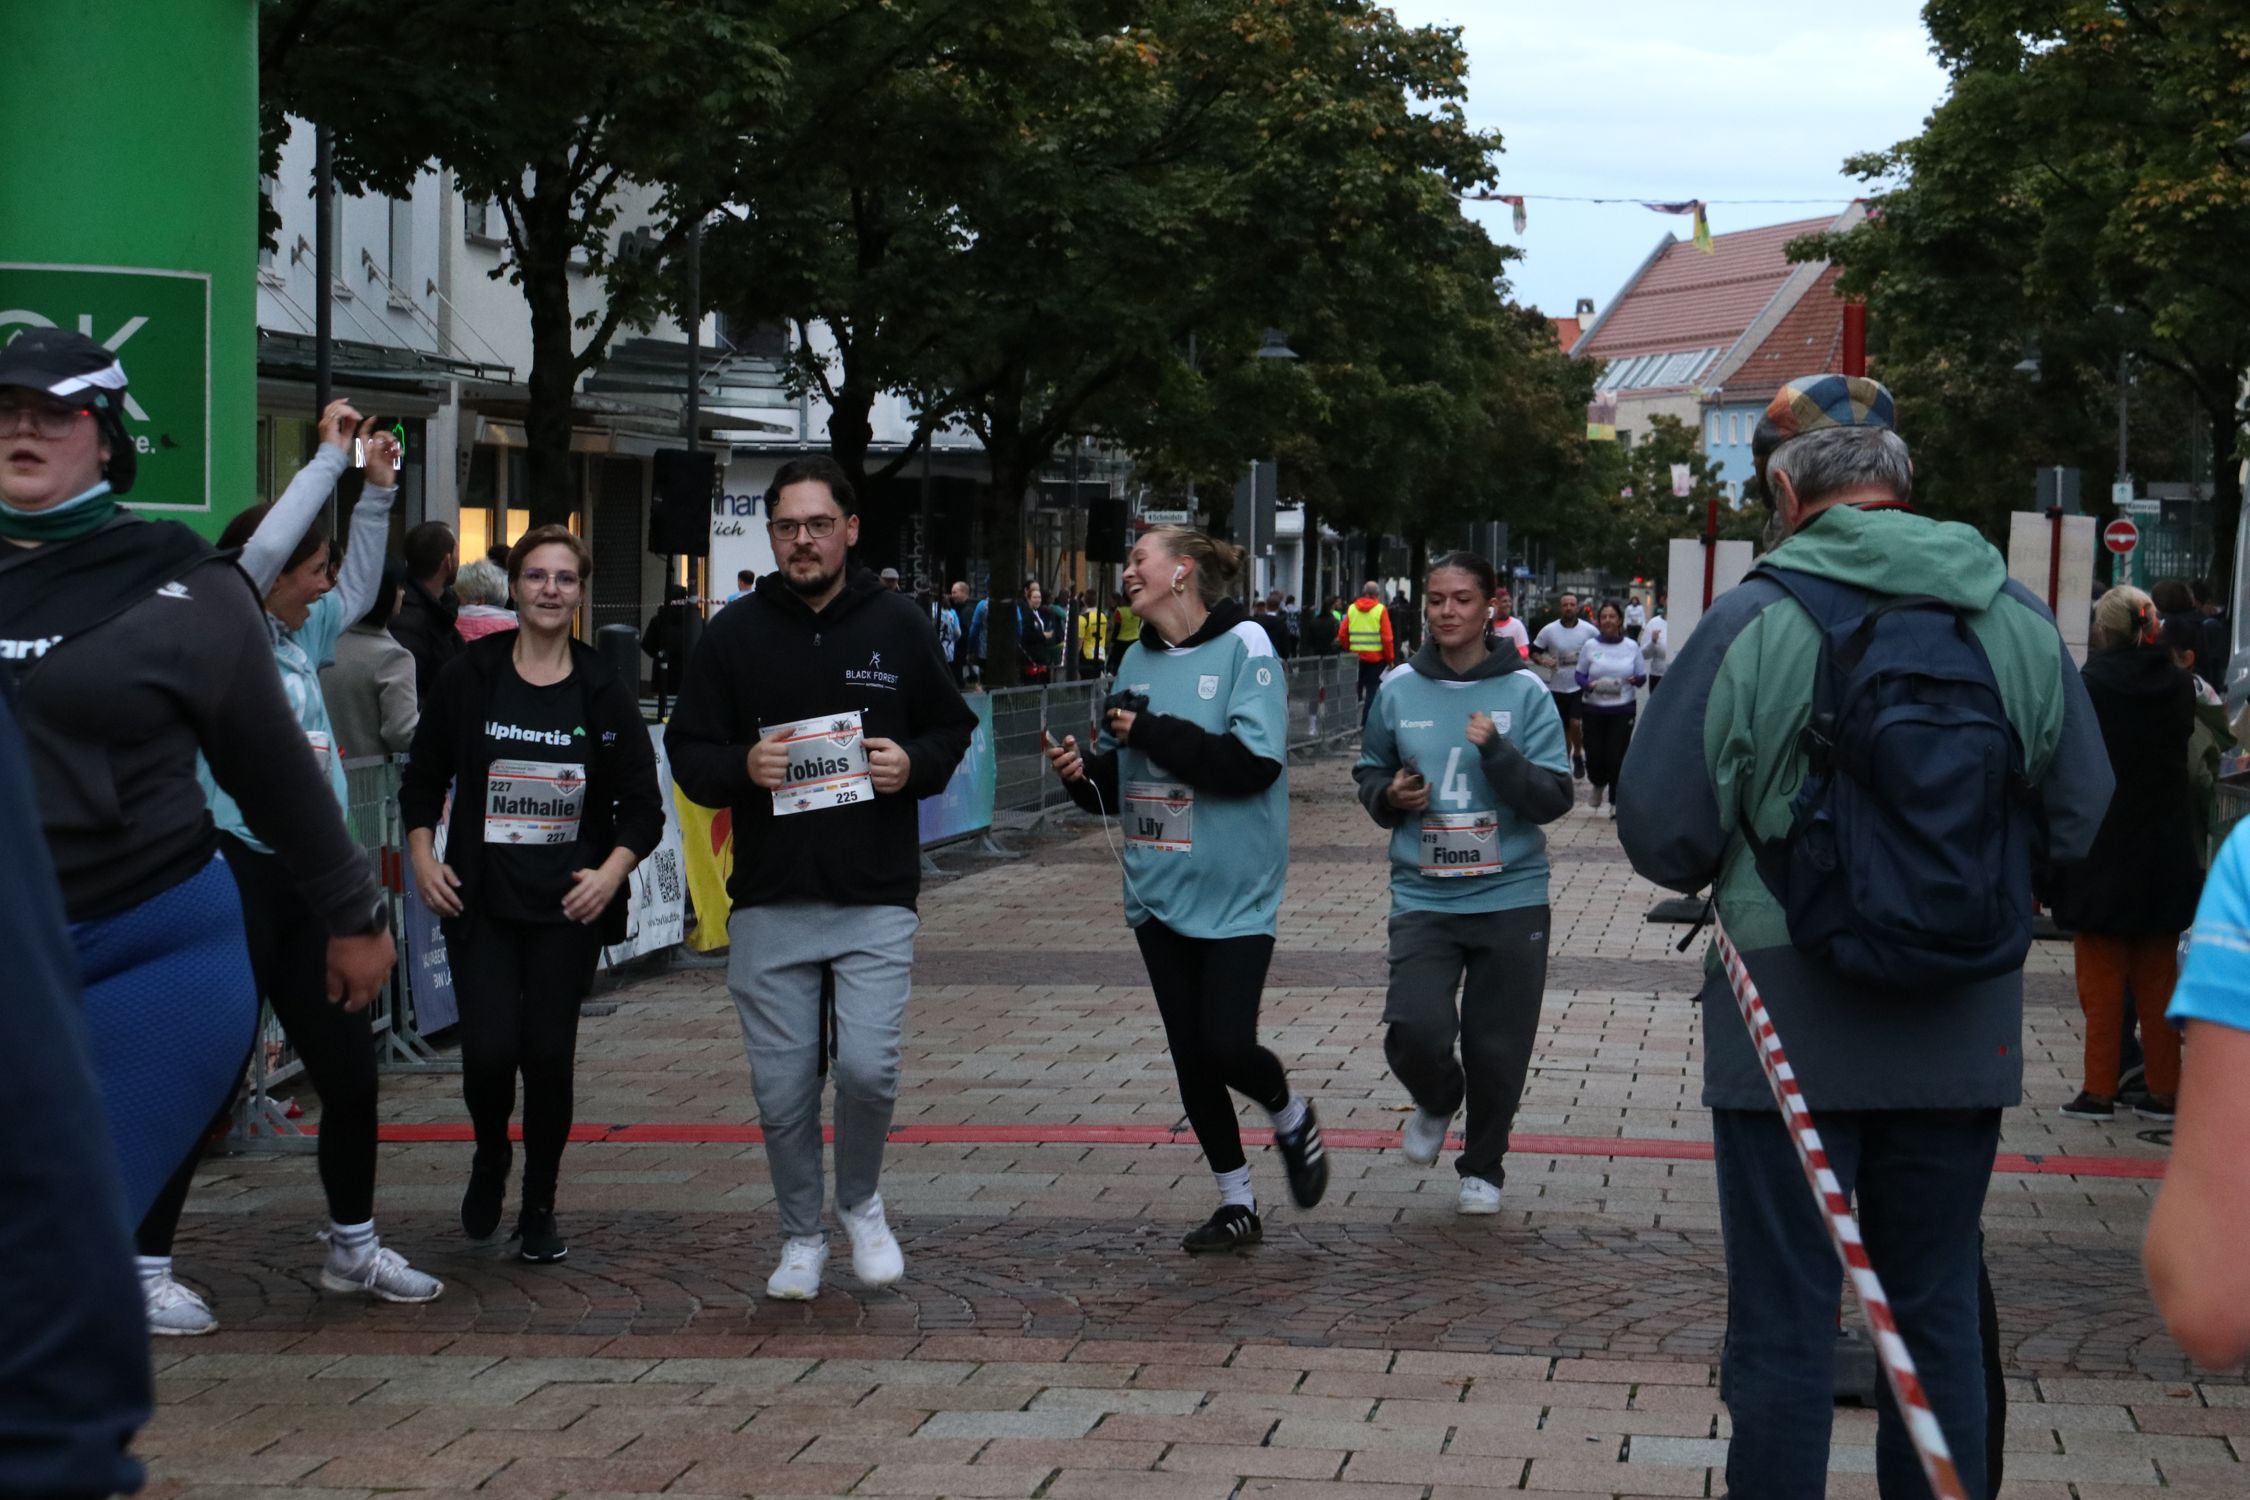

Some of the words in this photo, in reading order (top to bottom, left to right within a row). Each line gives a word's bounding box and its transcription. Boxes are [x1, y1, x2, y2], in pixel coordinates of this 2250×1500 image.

[845, 669, 872, 680] BLACK
[873, 671, 899, 684] FOREST
[1440, 746, 1472, 810] 4
[489, 780, 513, 793] 227
[835, 790, 858, 805] 225
[491, 794, 576, 818] Nathalie
[1138, 816, 1165, 840] Lily
[546, 832, 566, 844] 227
[1422, 833, 1438, 844] 419
[1432, 846, 1481, 865] Fiona
